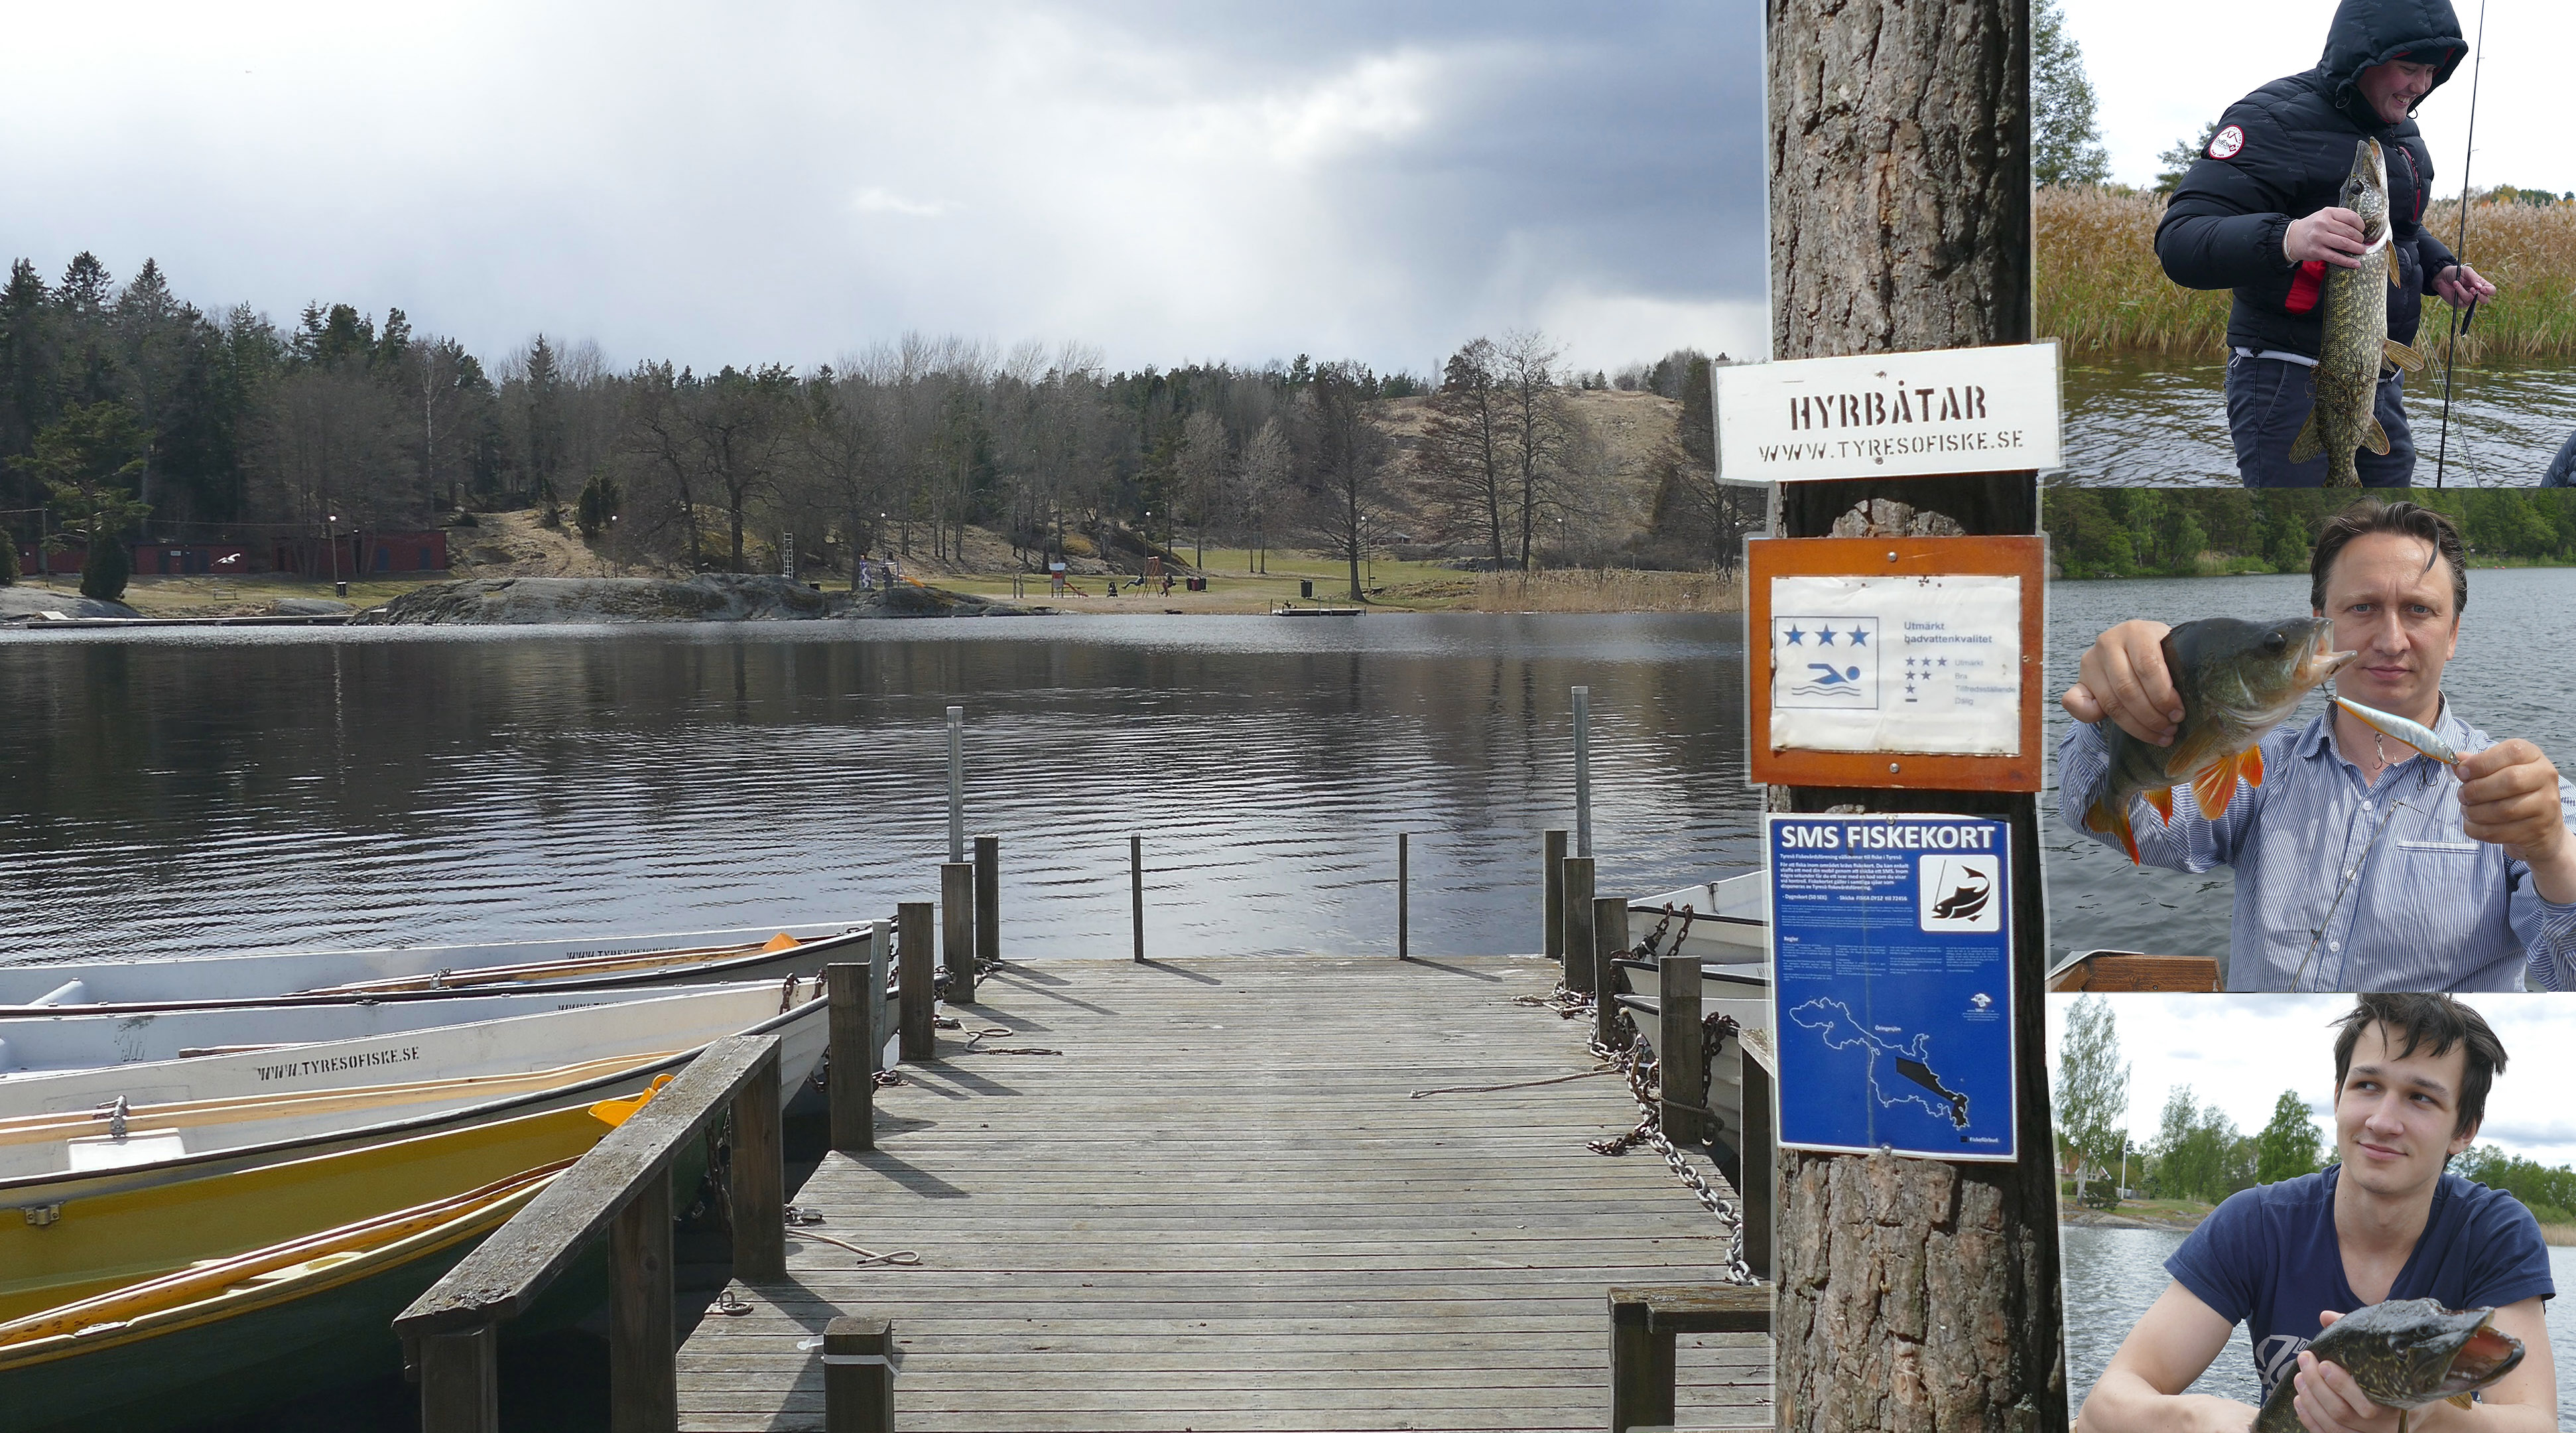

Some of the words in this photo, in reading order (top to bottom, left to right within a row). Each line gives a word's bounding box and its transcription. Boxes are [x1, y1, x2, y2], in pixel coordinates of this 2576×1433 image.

[1790, 380, 1986, 431] HYRBÅTAR
[1759, 430, 2024, 462] WWW.TYRESOFISKE.SE
[1904, 622, 1945, 630] Utmärkt
[1904, 634, 1992, 644] badvattenkvalitet
[1781, 825, 1838, 849] SMS
[1847, 825, 1995, 849] FISKEKORT
[257, 1046, 419, 1081] WWW.TYRESOFISKE.SE
